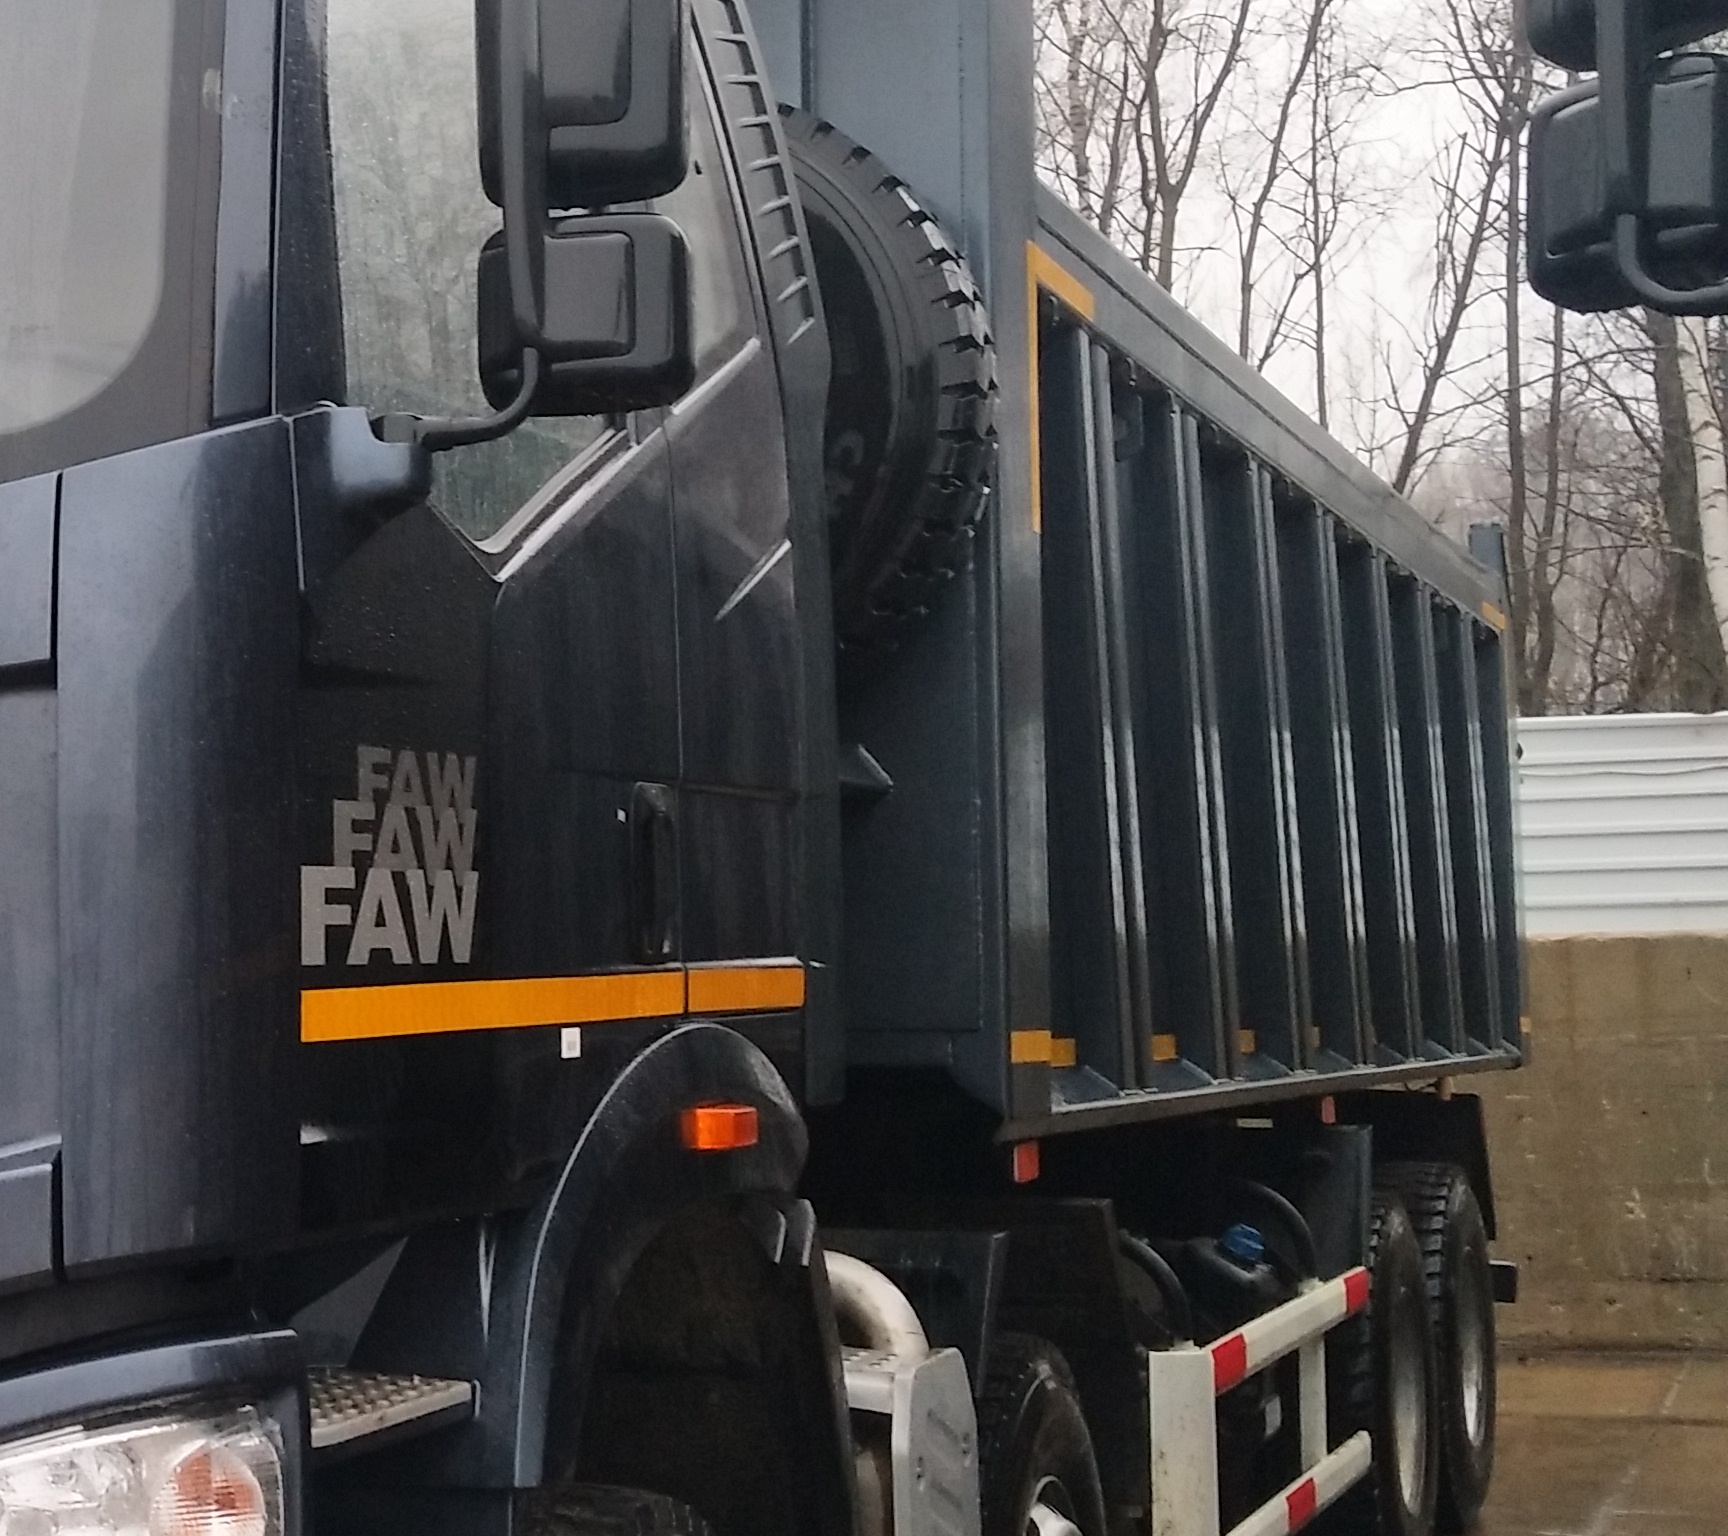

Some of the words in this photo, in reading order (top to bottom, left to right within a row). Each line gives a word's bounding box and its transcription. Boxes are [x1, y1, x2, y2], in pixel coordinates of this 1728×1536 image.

[357, 744, 477, 810] FAW
[333, 798, 478, 886] FAW
[300, 865, 479, 965] FAW
